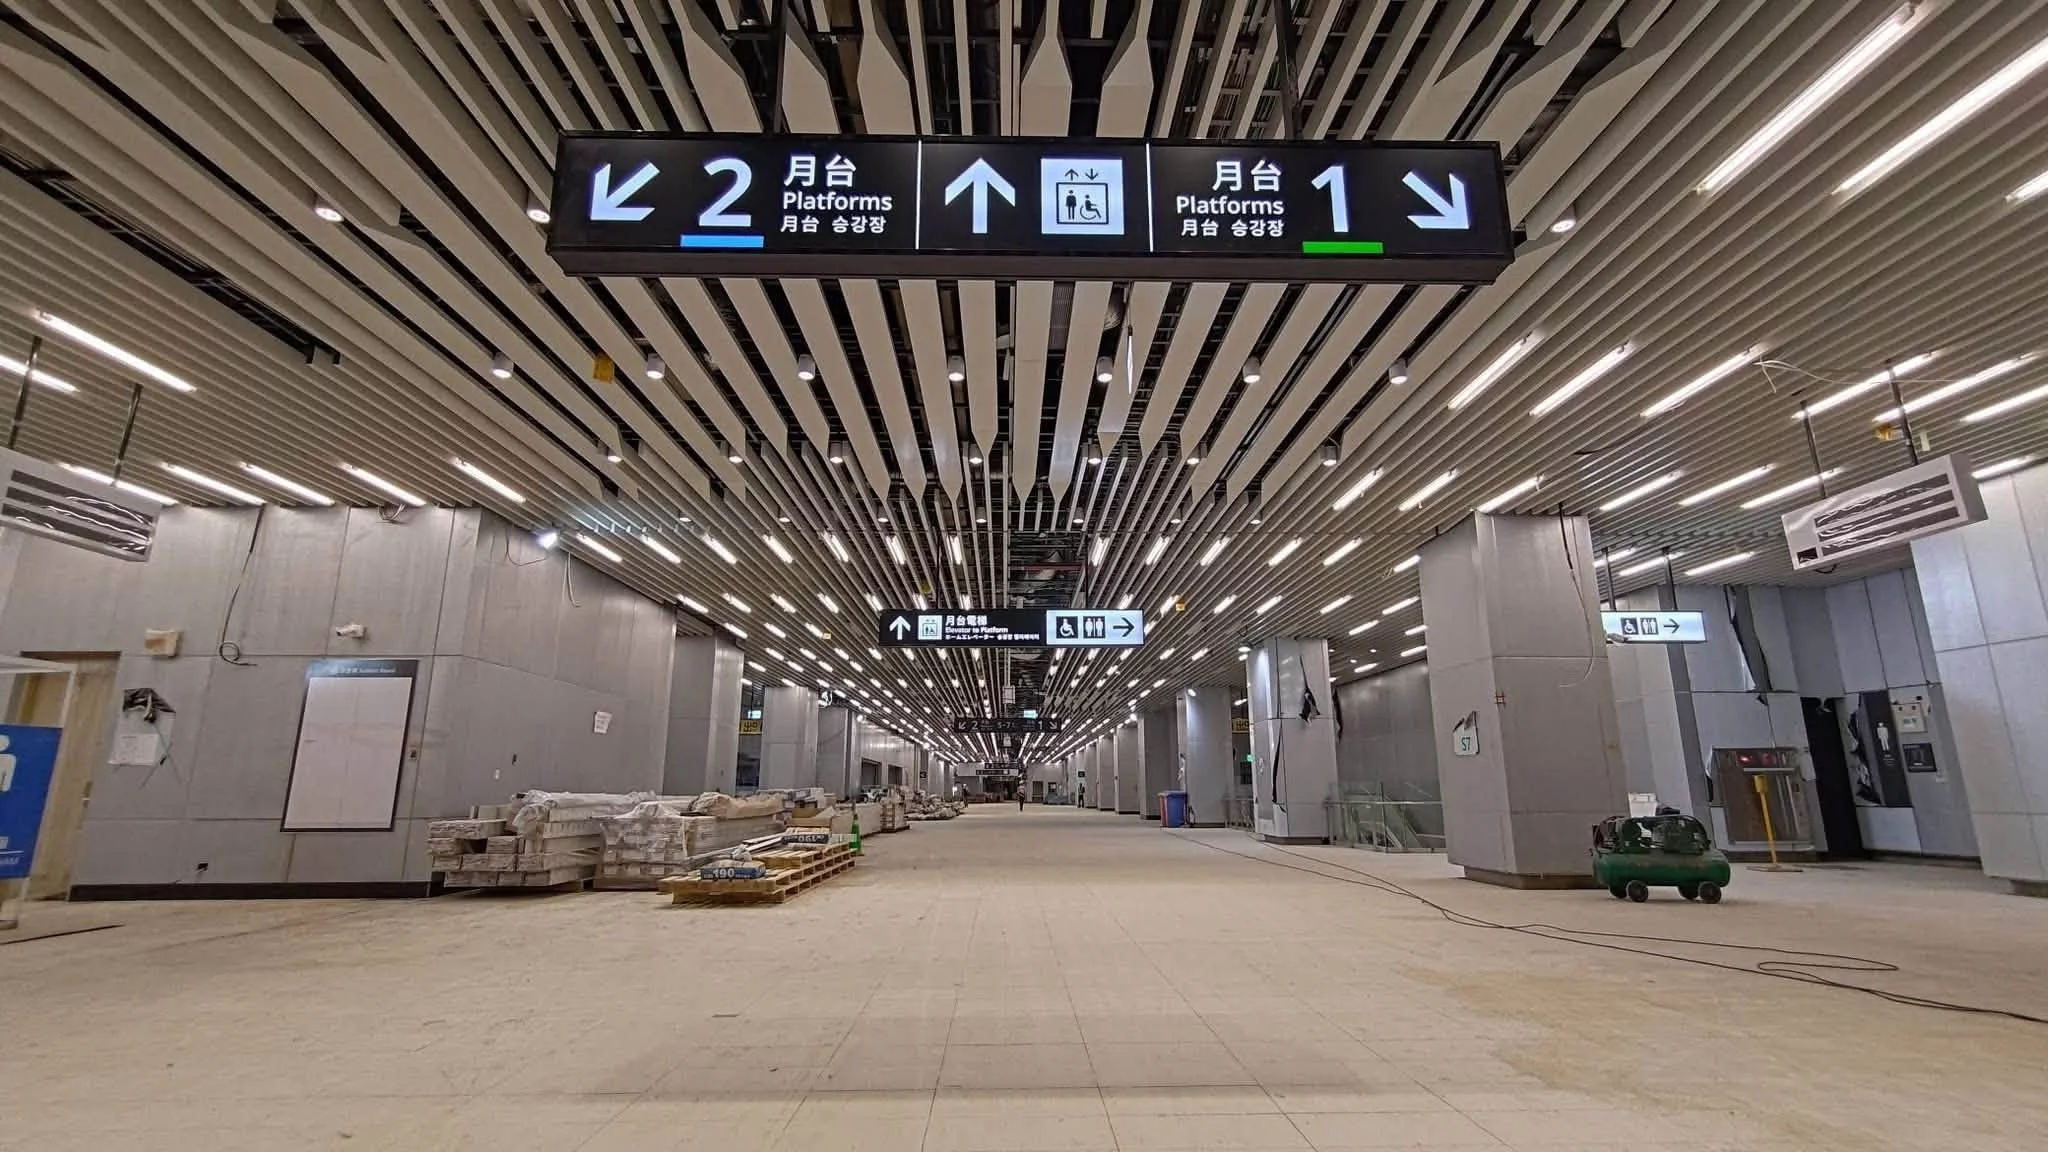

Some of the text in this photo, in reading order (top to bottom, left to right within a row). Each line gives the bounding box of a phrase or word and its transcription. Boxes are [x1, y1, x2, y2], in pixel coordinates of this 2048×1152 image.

[784, 155, 857, 188] 月台
[1212, 160, 1282, 192] 月台
[699, 158, 752, 227] 2
[783, 191, 893, 211] Platforms
[1312, 166, 1349, 233] 1
[1176, 196, 1285, 215] Platforms
[781, 215, 887, 234] 月台 승강장
[1181, 219, 1285, 238] 月台 승강장
[945, 626, 971, 634] Elevator
[980, 626, 1009, 634] Platform
[971, 720, 979, 730] 2
[1038, 720, 1043, 730] 1
[1461, 736, 1471, 752] S7
[713, 867, 735, 878] 190
